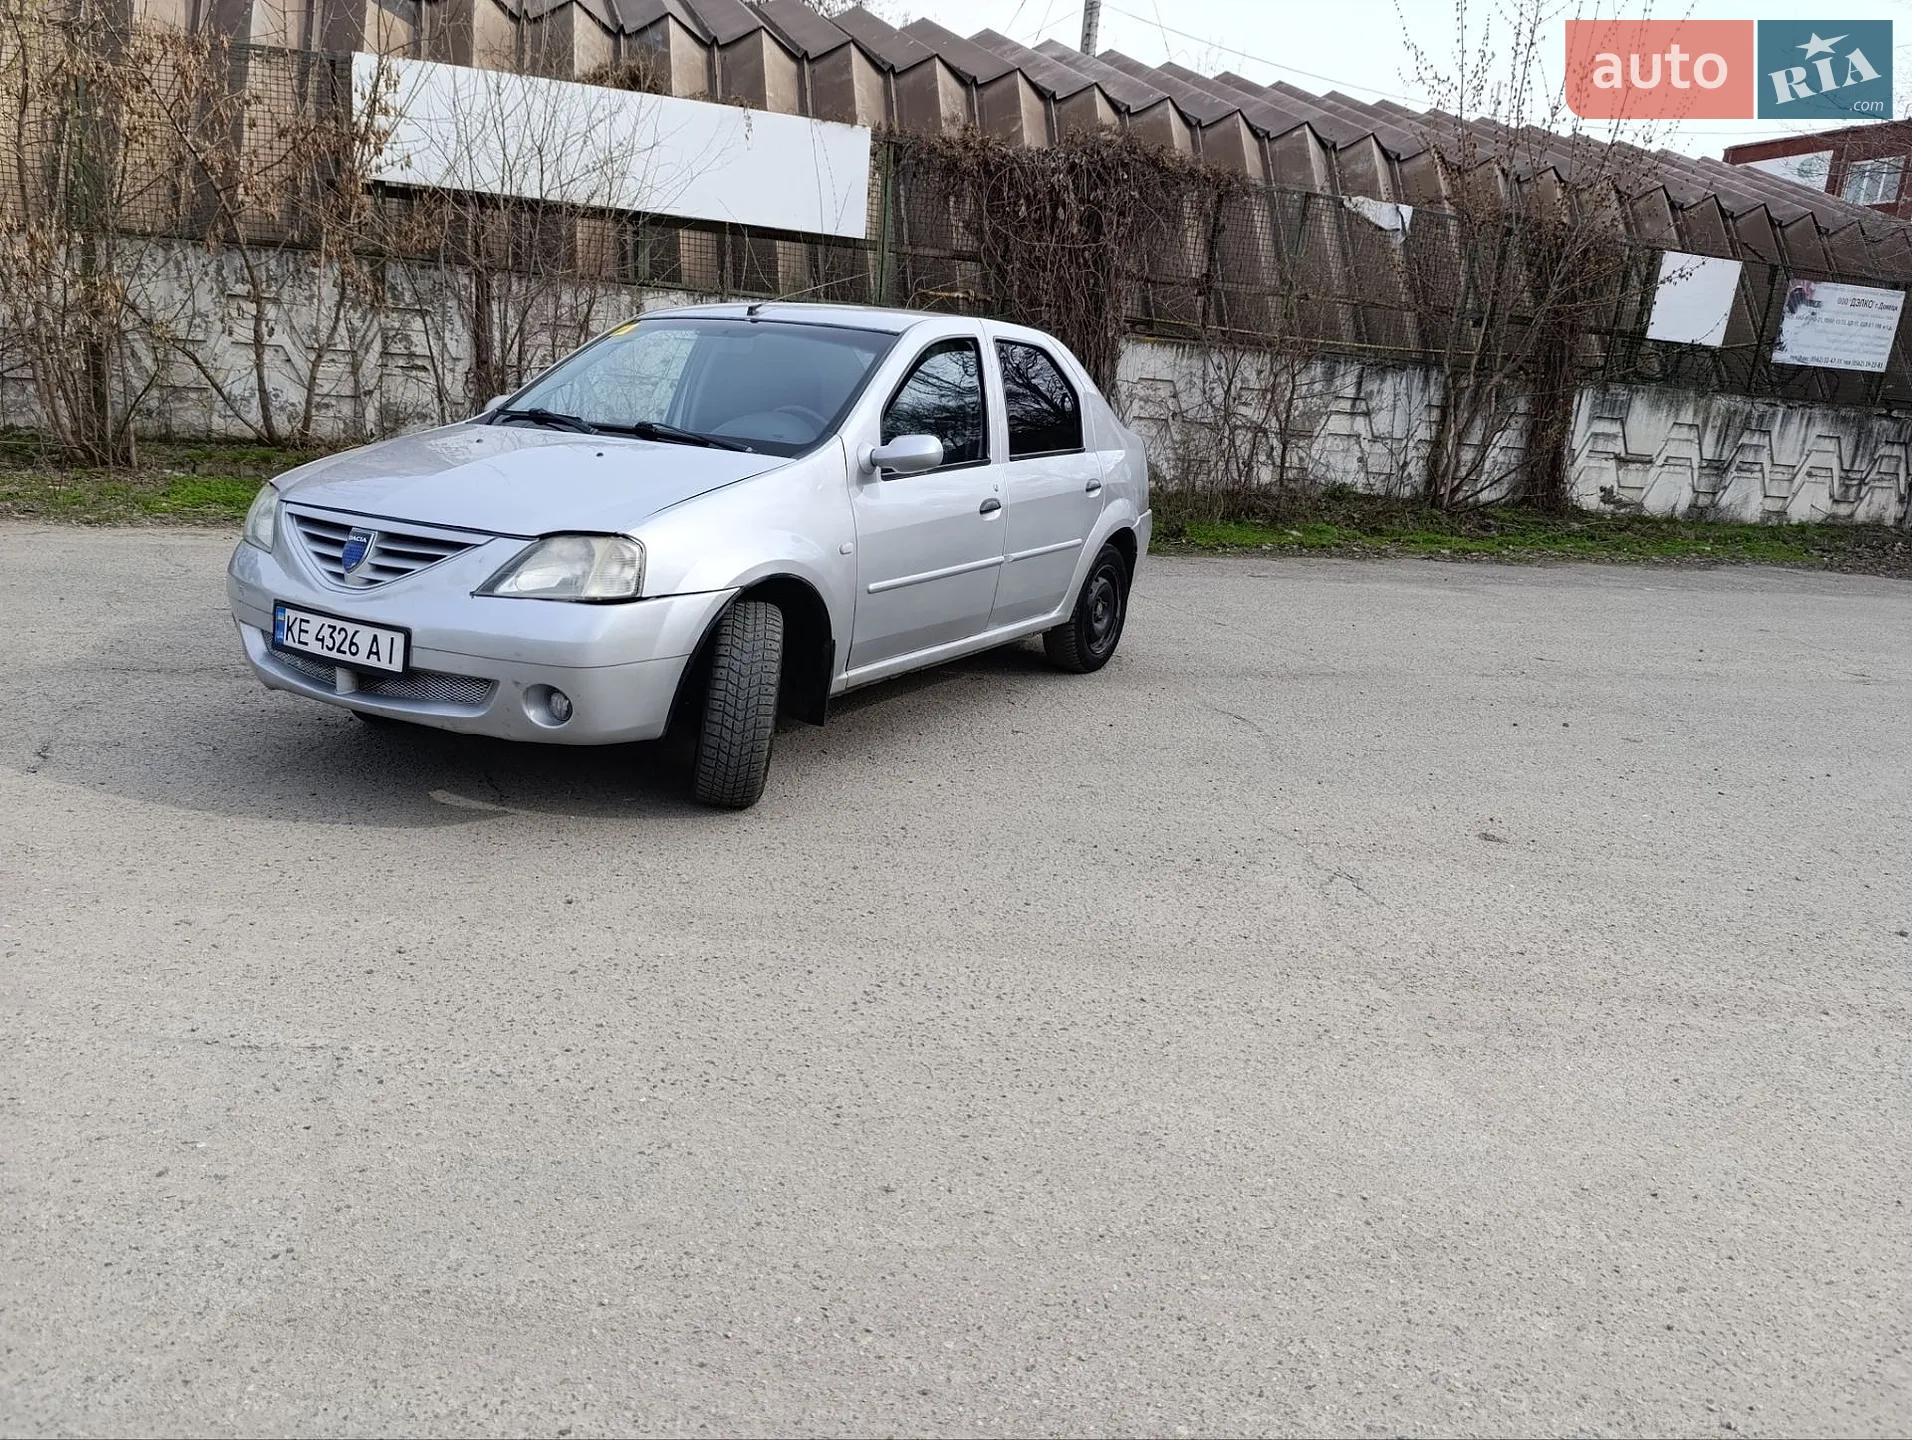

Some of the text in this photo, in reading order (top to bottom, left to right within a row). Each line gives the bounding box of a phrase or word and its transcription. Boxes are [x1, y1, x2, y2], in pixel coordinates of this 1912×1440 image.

[348, 535, 367, 544] DACIA
[285, 615, 395, 665] KE 4326 AI
